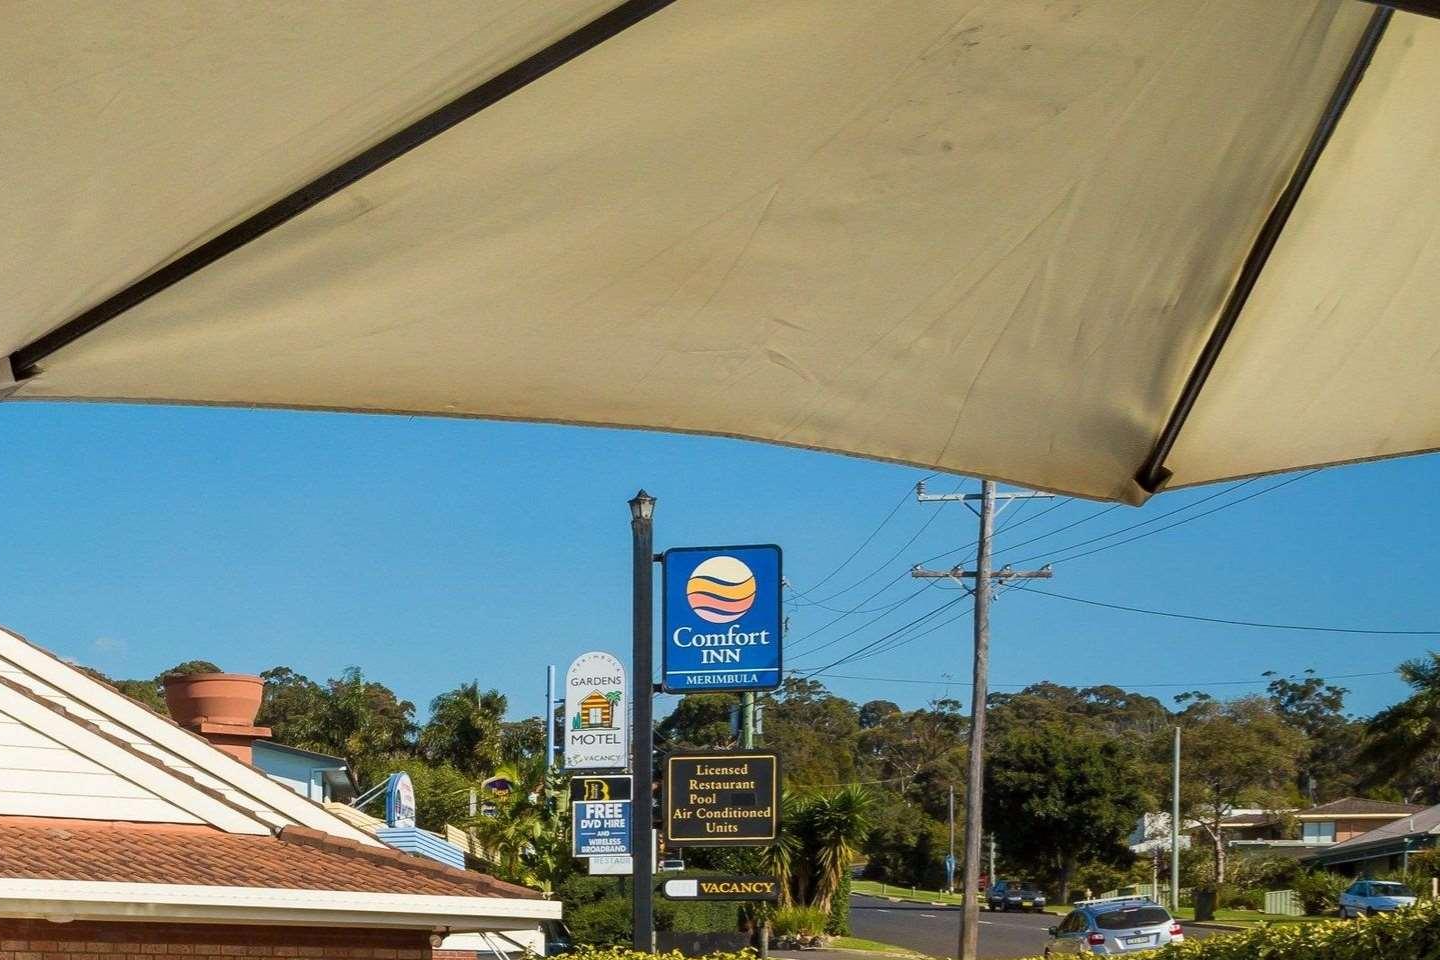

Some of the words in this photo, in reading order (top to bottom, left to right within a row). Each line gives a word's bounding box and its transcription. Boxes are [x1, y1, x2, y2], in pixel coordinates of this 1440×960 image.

[672, 624, 770, 648] Comfort
[701, 648, 742, 664] INN
[570, 676, 622, 687] GARDENS
[686, 673, 758, 685] MERIMBULA
[570, 733, 622, 745] MOTEL
[696, 764, 749, 776] Licensed
[689, 780, 755, 790] Restaurant
[689, 793, 717, 805] Pool
[585, 803, 623, 819] FREE
[673, 808, 693, 819] Air
[696, 807, 771, 819] Conditioned
[581, 819, 602, 829] DVD
[604, 818, 626, 828] HIRE
[705, 822, 739, 833] Units
[588, 838, 622, 846] WIRELESS
[581, 845, 627, 853] BROADBAND
[700, 882, 776, 894] VACANCY
